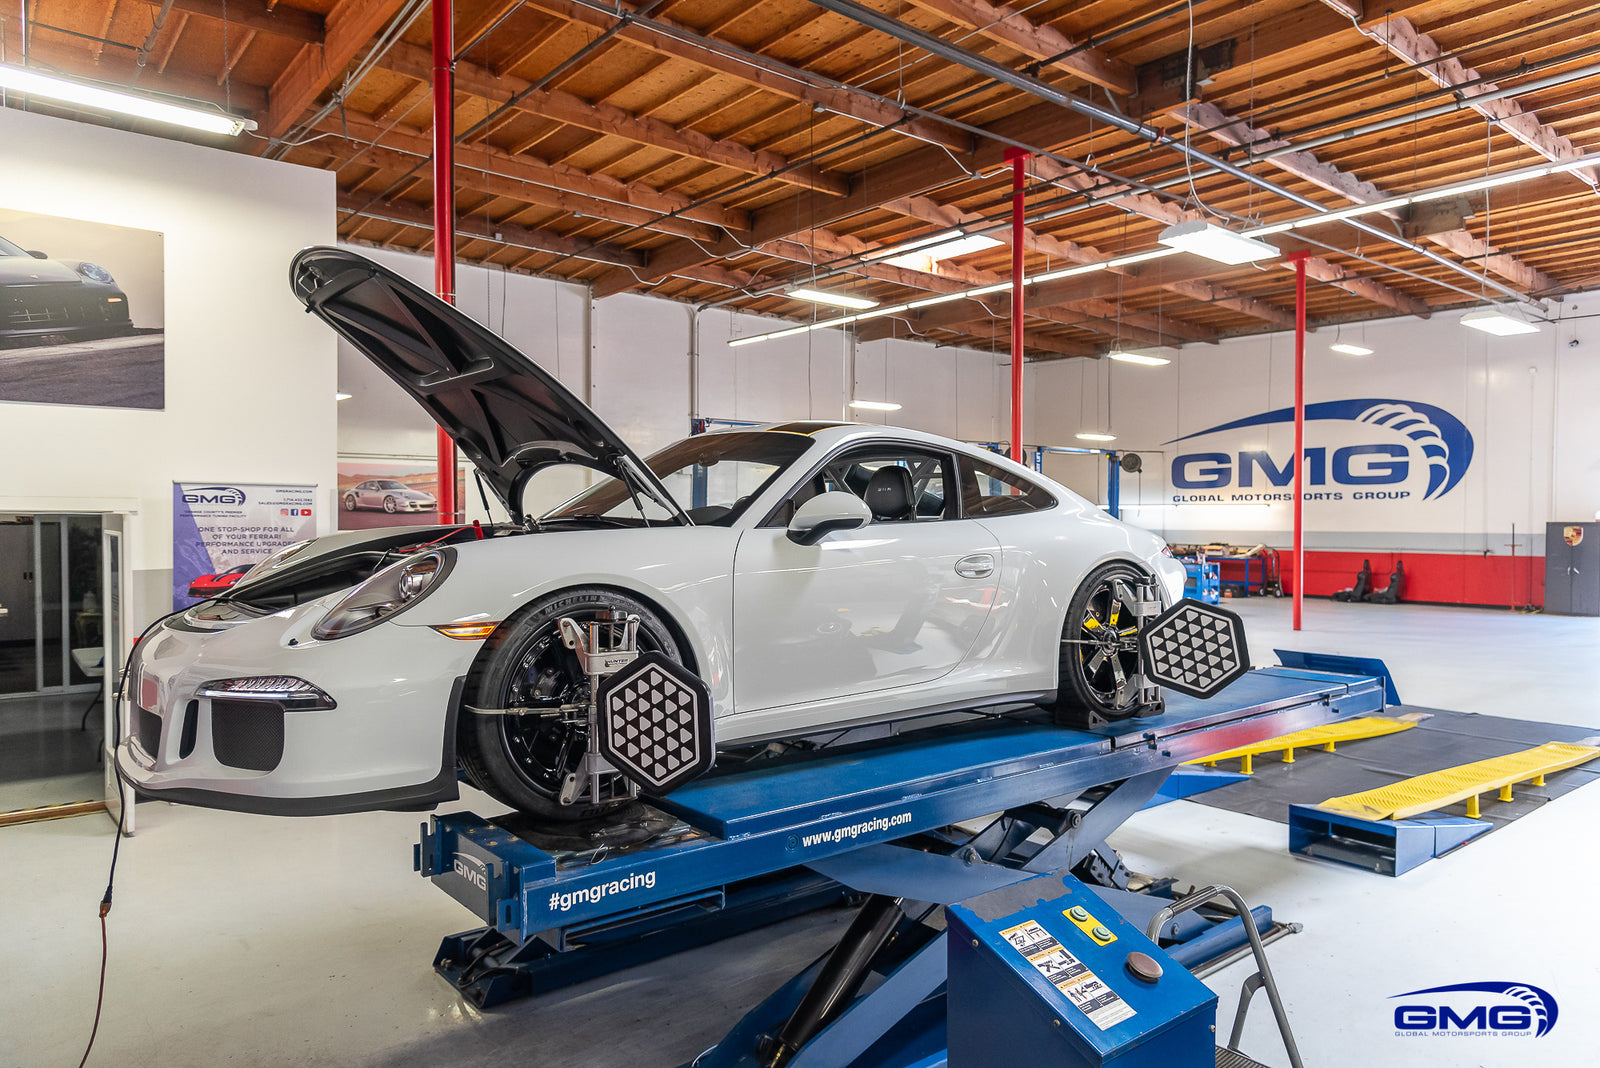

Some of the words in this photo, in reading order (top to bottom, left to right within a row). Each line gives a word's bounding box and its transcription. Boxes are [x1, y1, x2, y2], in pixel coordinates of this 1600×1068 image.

[1171, 443, 1410, 490] GMG
[182, 494, 236, 504] GMG
[1172, 494, 1225, 503] GLOBAL
[1231, 492, 1343, 502] MOTORSORTS
[1353, 491, 1411, 500] GROUP
[544, 595, 598, 614] MICHELIN
[802, 811, 912, 848] www.gmgracing.com
[453, 858, 487, 892] GMG
[549, 870, 656, 912] #gmgracing
